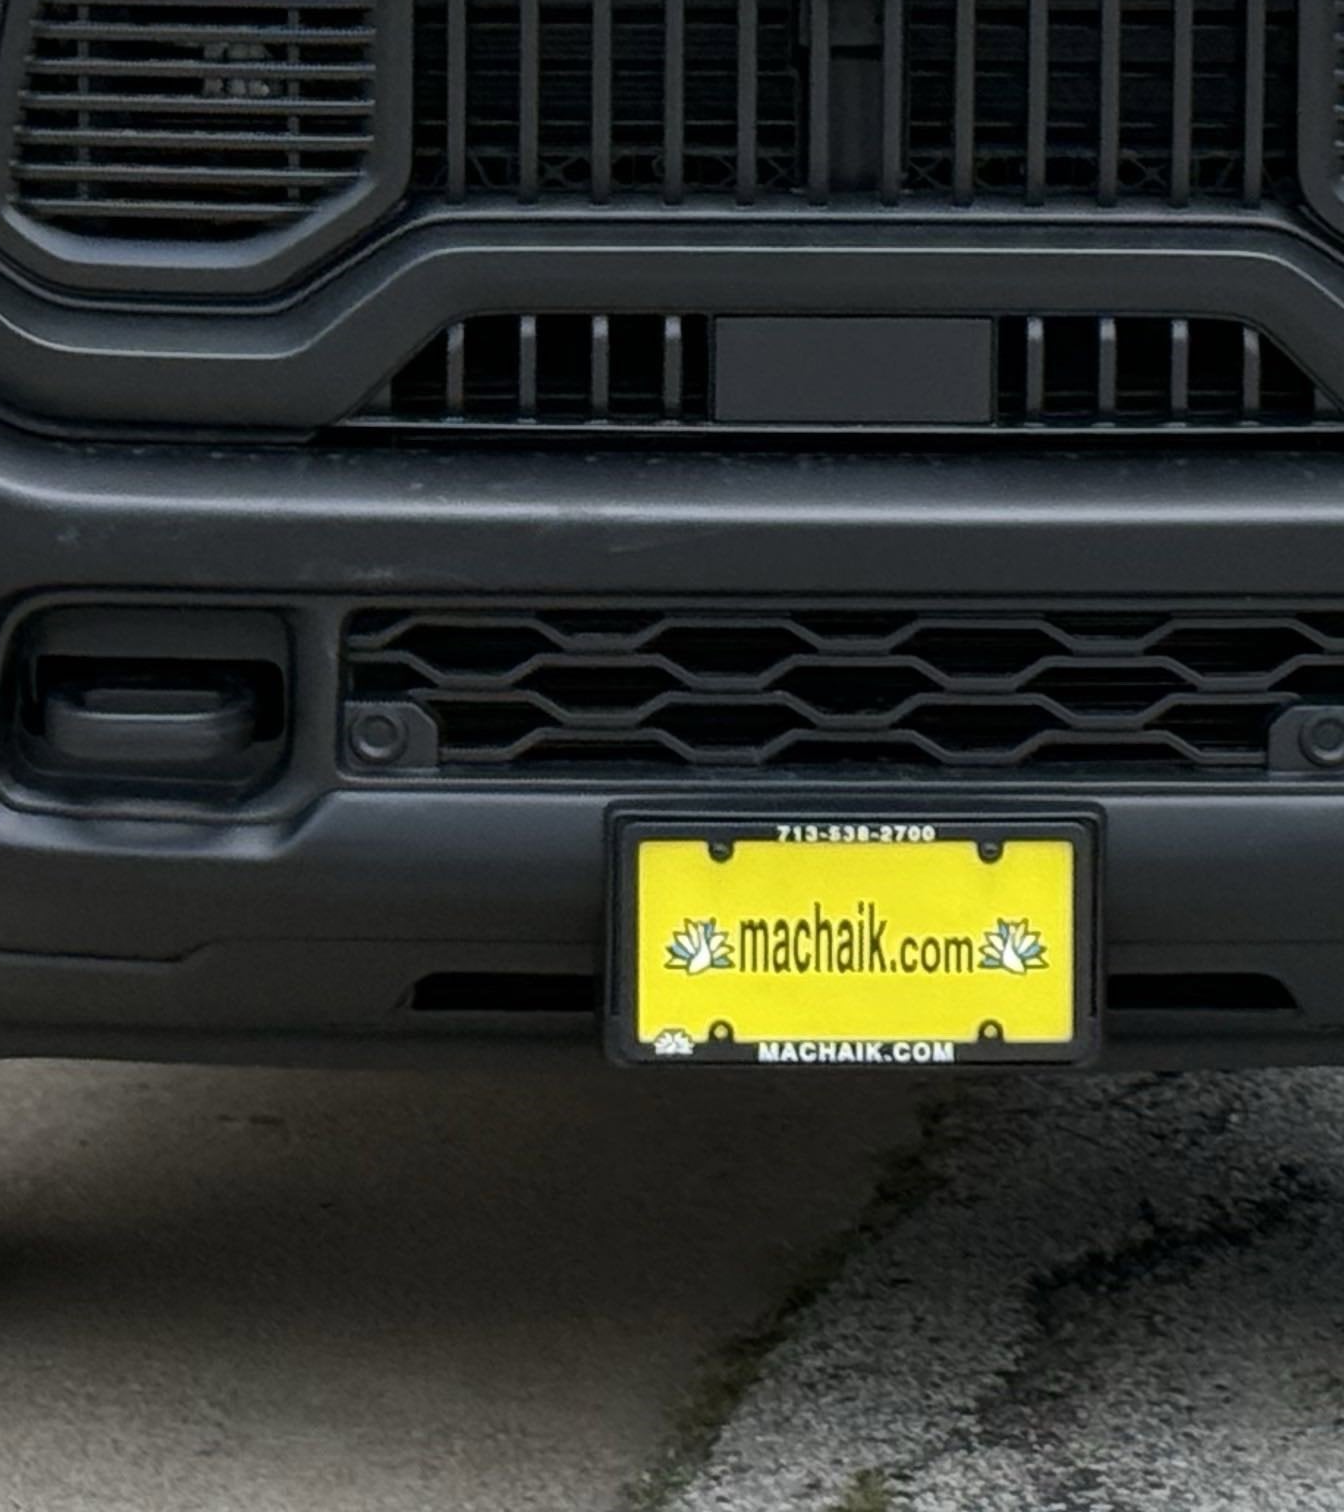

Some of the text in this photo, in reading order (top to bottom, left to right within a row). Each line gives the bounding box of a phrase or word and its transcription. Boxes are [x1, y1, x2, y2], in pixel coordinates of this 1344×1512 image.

[776, 824, 936, 843] 713-538-2700
[738, 901, 975, 974] machaik.com
[757, 1041, 955, 1062] MACHAIK.COM
